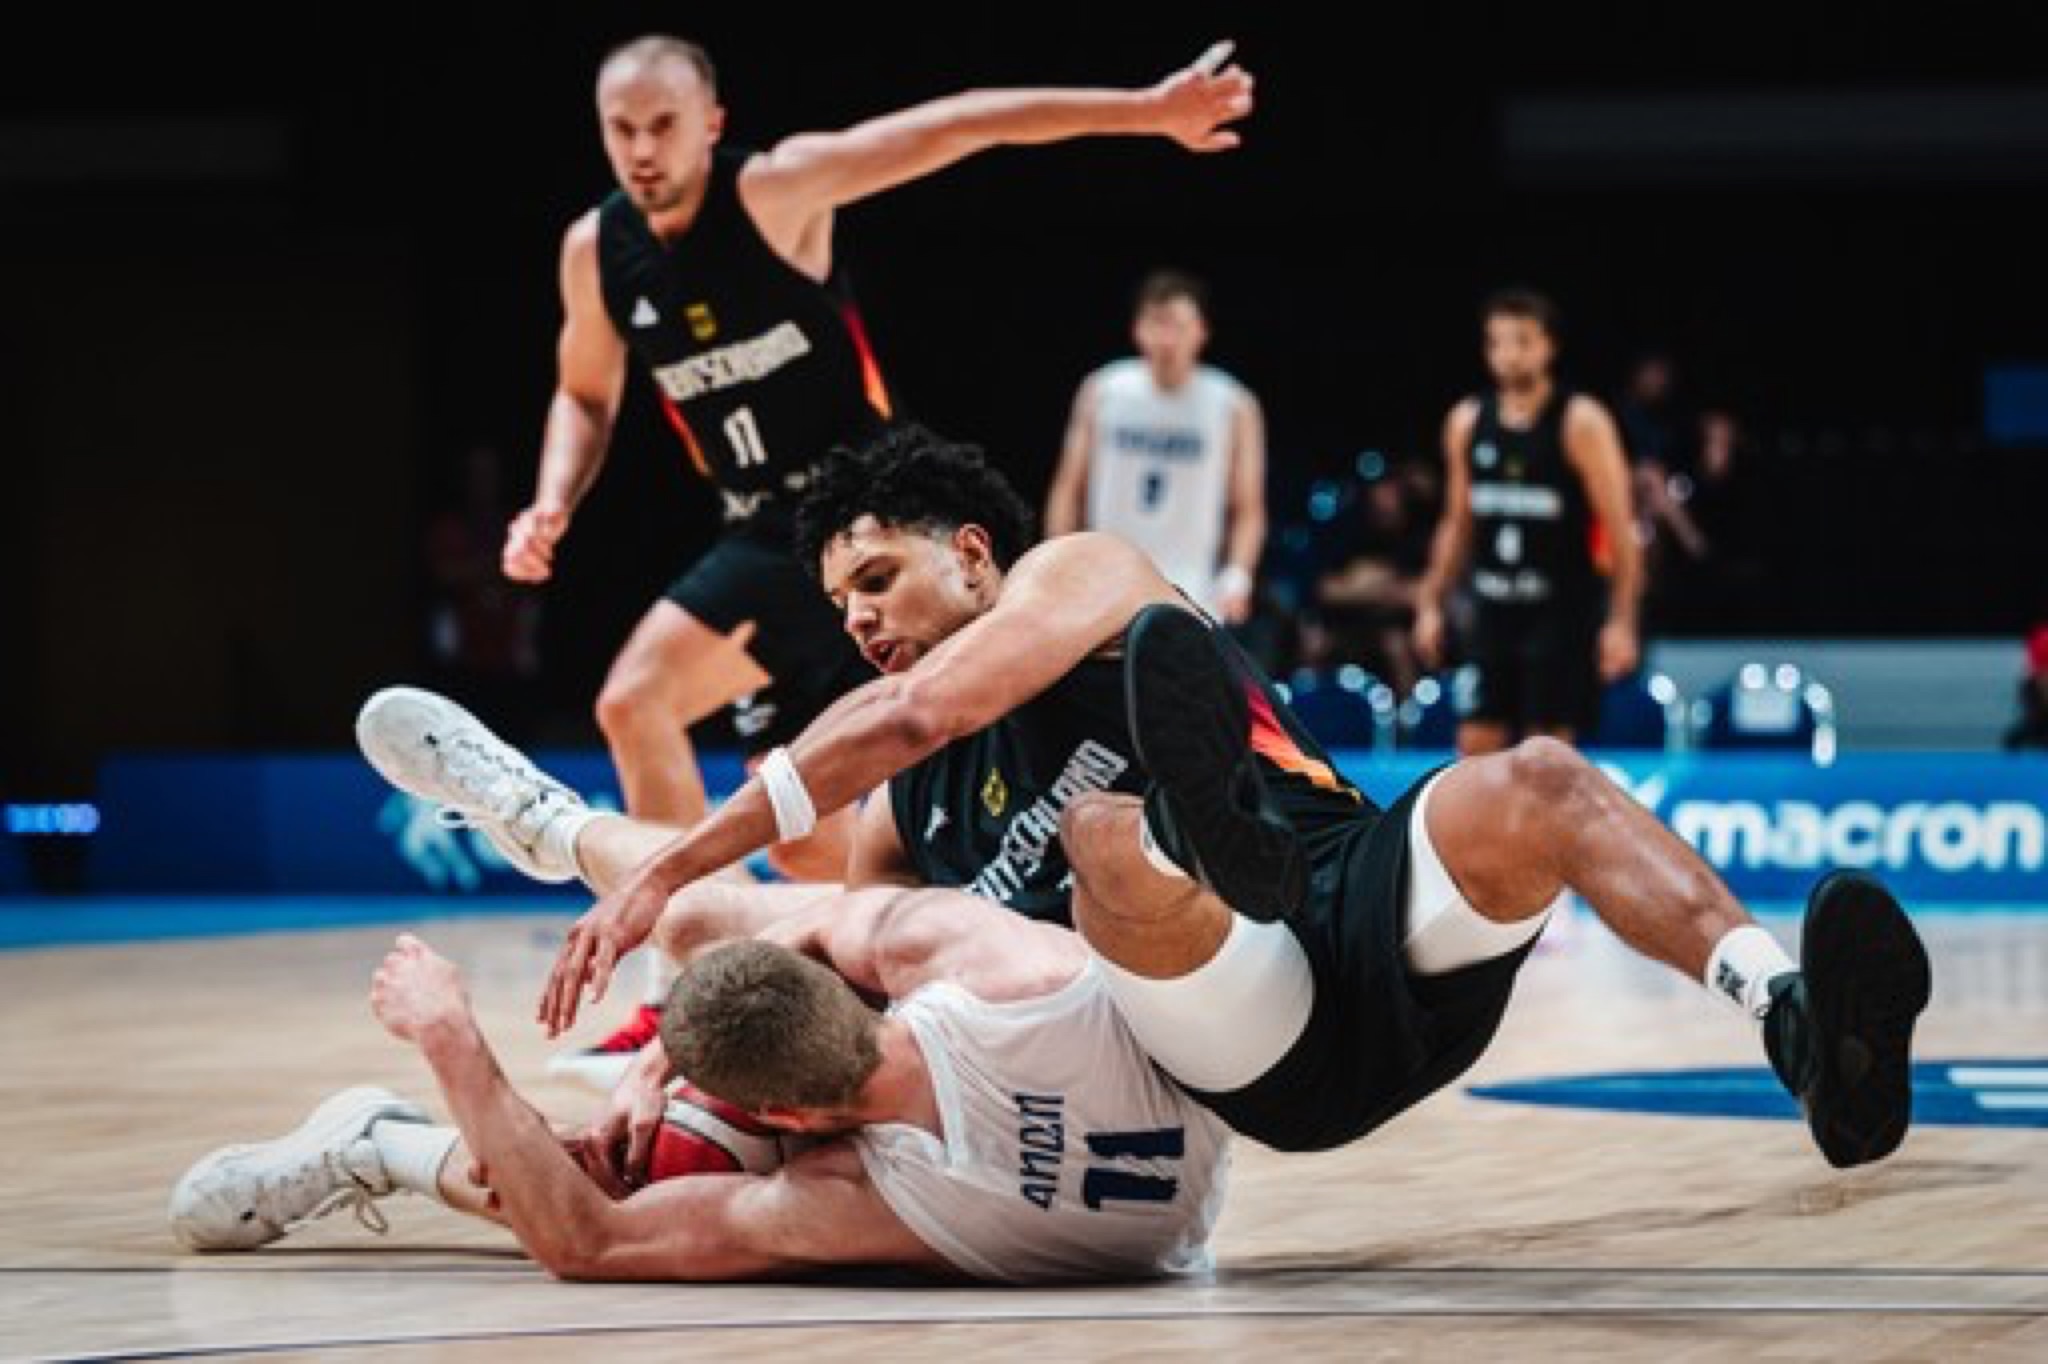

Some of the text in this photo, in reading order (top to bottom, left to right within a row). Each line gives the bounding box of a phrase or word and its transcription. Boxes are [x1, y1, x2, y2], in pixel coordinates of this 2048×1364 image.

[723, 404, 768, 469] 11
[1672, 800, 2044, 871] macron
[1083, 1127, 1186, 1211] 11
